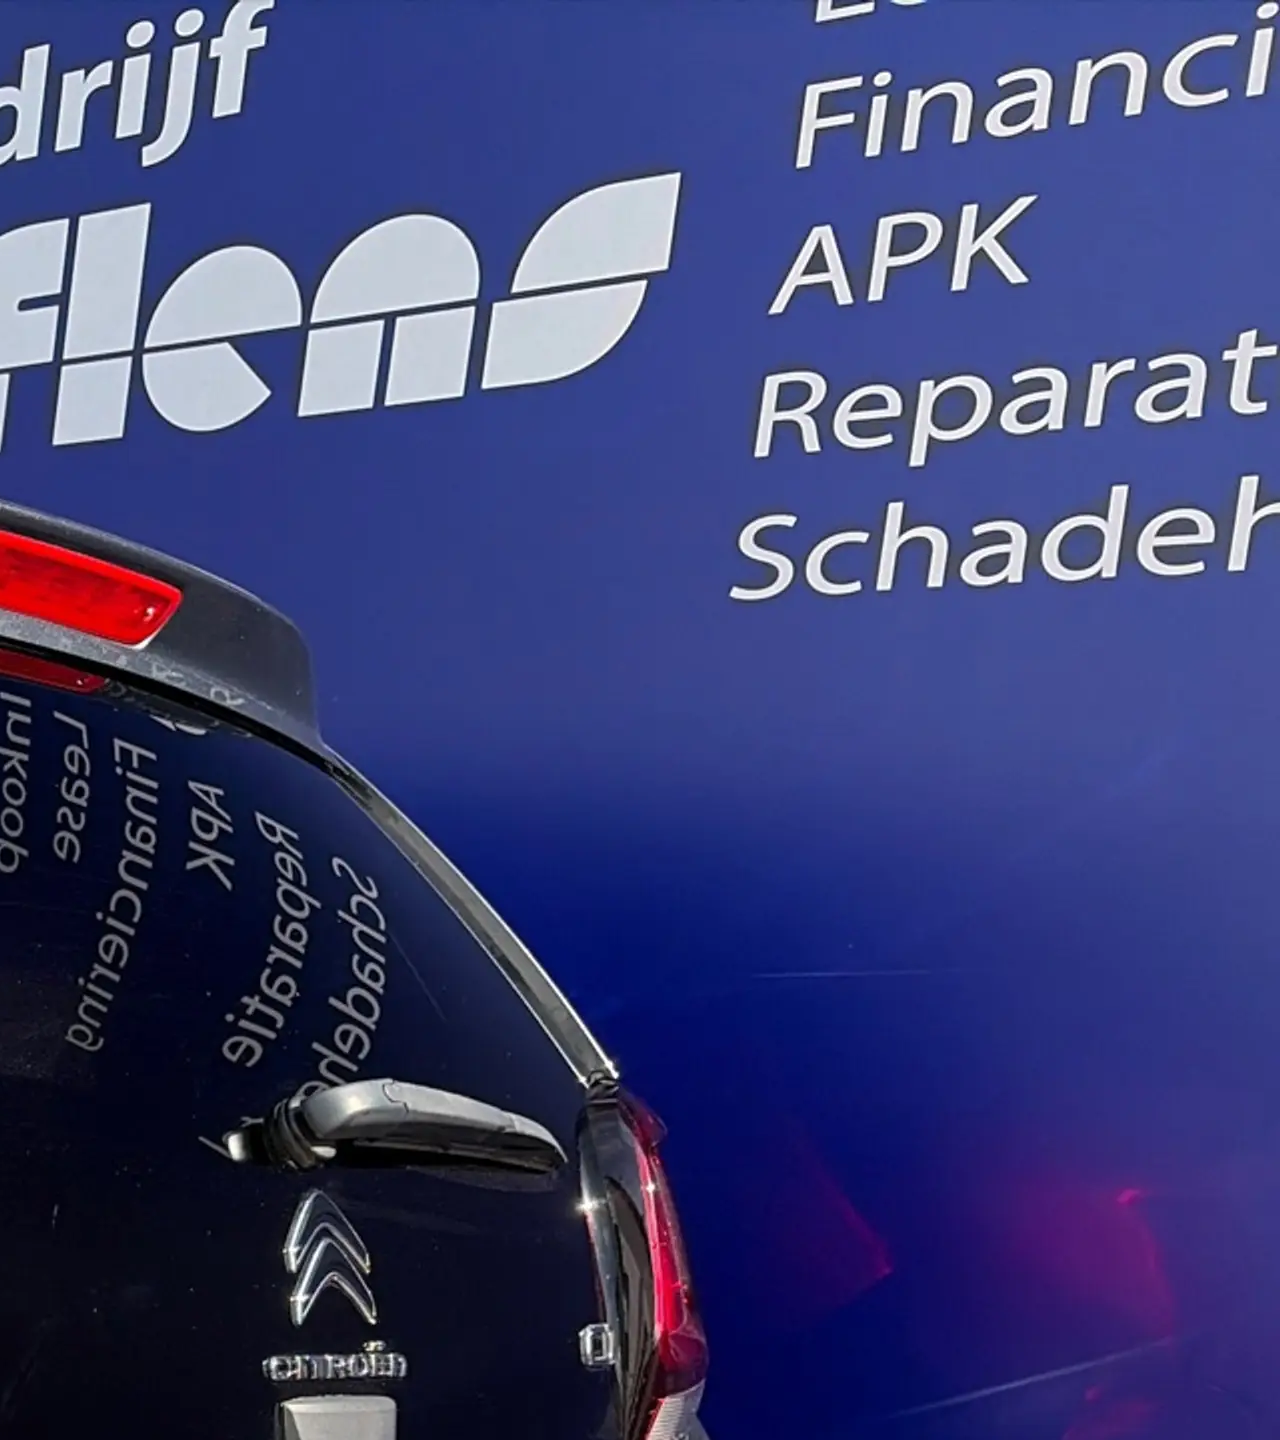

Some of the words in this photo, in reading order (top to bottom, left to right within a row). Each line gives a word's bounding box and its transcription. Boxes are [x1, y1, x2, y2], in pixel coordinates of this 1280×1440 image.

[795, 2, 1279, 168] Financi
[769, 195, 1037, 314] APK
[754, 329, 1278, 466] Reparat
